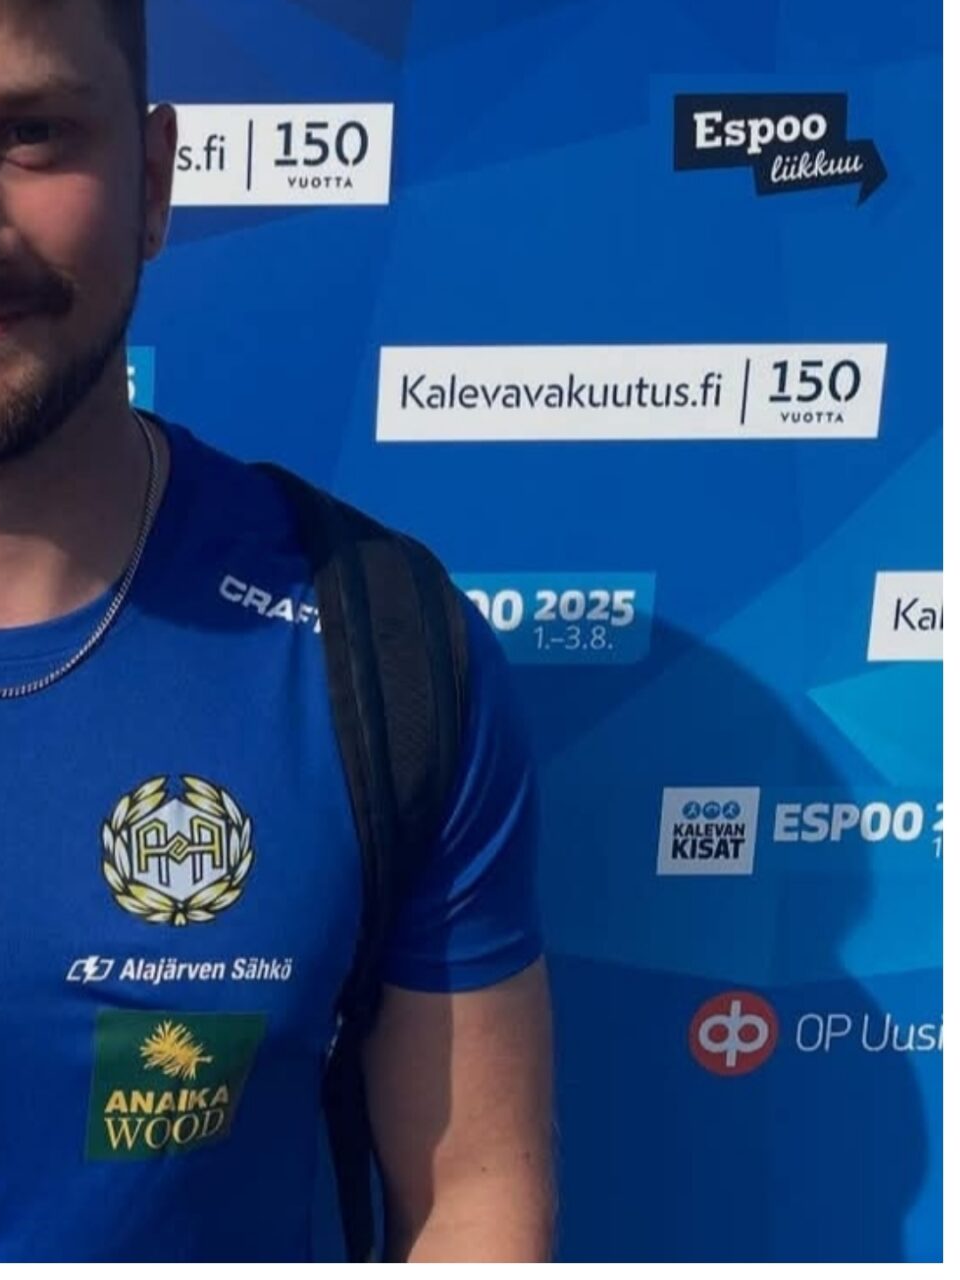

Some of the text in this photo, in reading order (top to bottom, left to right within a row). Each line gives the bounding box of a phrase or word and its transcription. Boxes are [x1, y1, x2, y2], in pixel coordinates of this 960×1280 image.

[274, 120, 370, 168] 150
[694, 112, 828, 155] Espoo
[287, 176, 354, 189] VUOTTA
[770, 148, 865, 184] liikkuu
[400, 360, 862, 412] Kalevavakuutus.fi 150
[781, 411, 845, 424] VUOTTA
[533, 588, 637, 627] 2025
[673, 822, 746, 839] KALEVAN
[773, 801, 924, 842] ESPOO
[670, 837, 746, 861] KISAT
[119, 956, 293, 985] Alajärven Sähkö
[796, 1013, 852, 1052] OP
[104, 1085, 230, 1115] ANAIKA
[104, 1108, 225, 1151] WOOD
